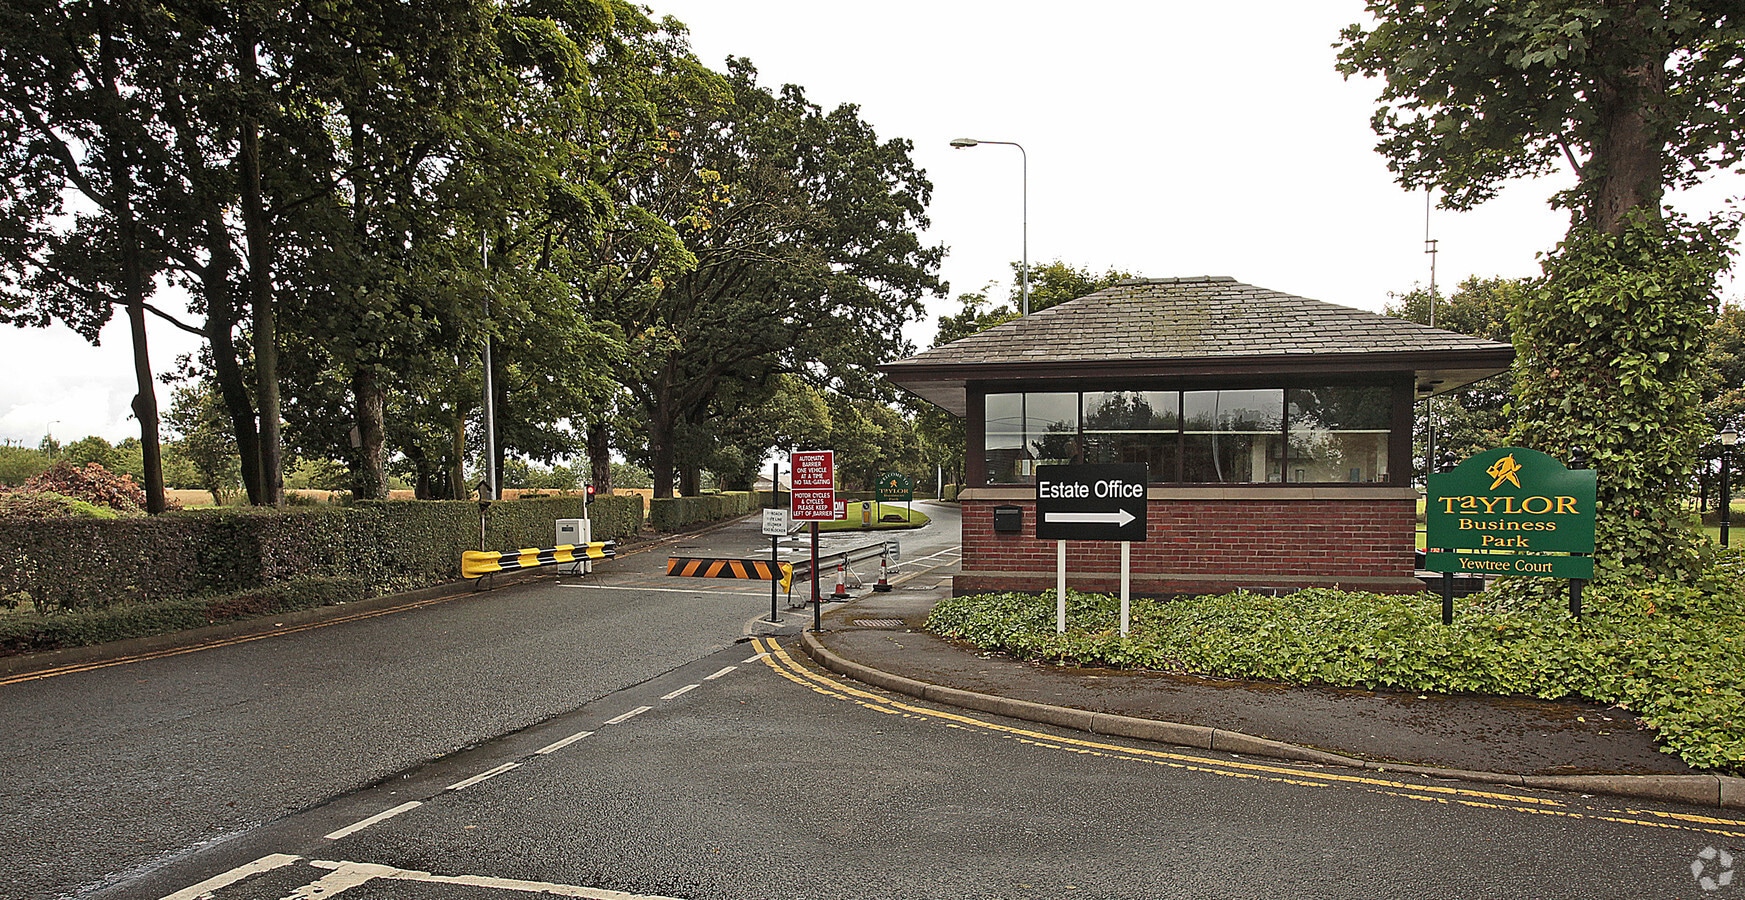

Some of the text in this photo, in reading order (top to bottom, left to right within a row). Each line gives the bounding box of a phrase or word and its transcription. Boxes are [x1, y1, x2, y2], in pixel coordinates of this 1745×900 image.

[879, 472, 909, 486] WELCOME TO
[1040, 480, 1144, 498] Estate Office
[1458, 518, 1556, 531] Business
[1481, 534, 1530, 548] Park
[1459, 558, 1553, 573] Yewtree Court
